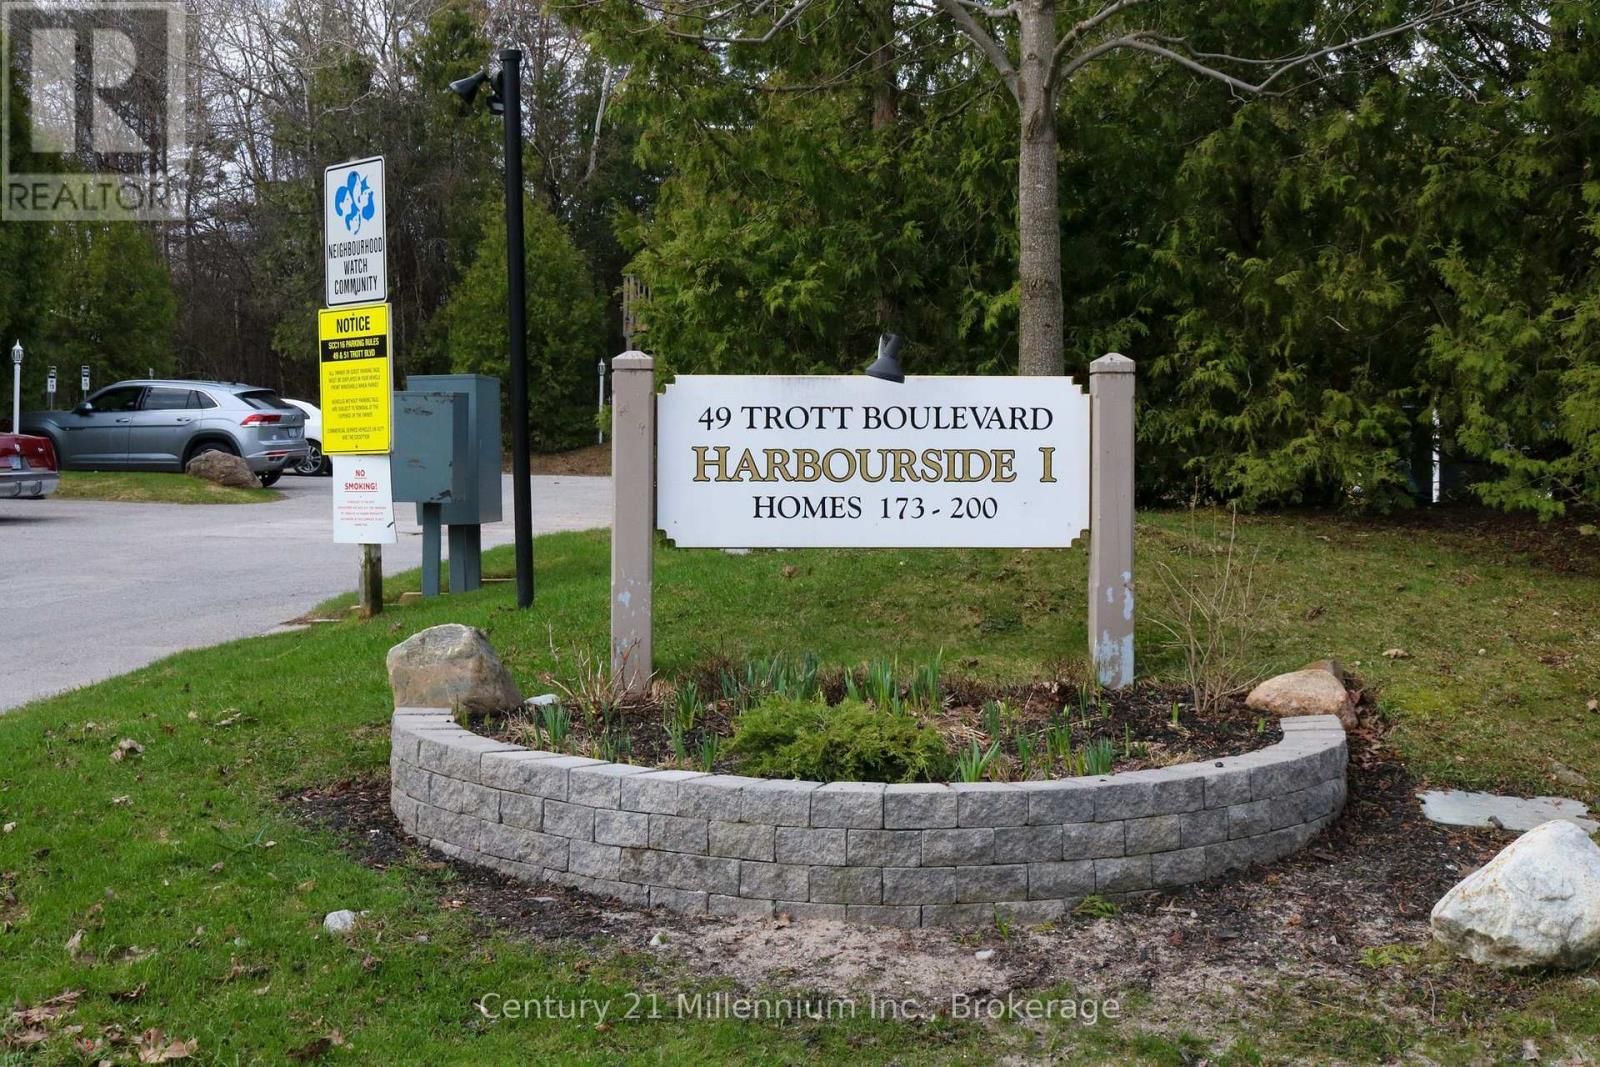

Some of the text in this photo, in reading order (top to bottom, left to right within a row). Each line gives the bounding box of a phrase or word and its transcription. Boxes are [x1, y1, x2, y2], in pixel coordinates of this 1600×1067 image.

[328, 237, 383, 259] NEIGHBOURHOOD
[343, 258, 368, 275] WATCH
[334, 275, 378, 296] COMMUNITY
[336, 316, 370, 333] NOTICE
[345, 339, 365, 348] PARKING
[365, 337, 379, 346] RULES
[333, 351, 339, 359] 49
[350, 349, 363, 358] TROTT
[364, 348, 376, 357] BLVD
[698, 406, 1053, 431] 49 TROTT BOULEVARD
[355, 469, 366, 477] NO
[691, 446, 1058, 483] HARBOURSIDE I
[344, 482, 378, 491] SMOKING!
[752, 496, 862, 519] HOMES
[950, 496, 998, 519] 200
